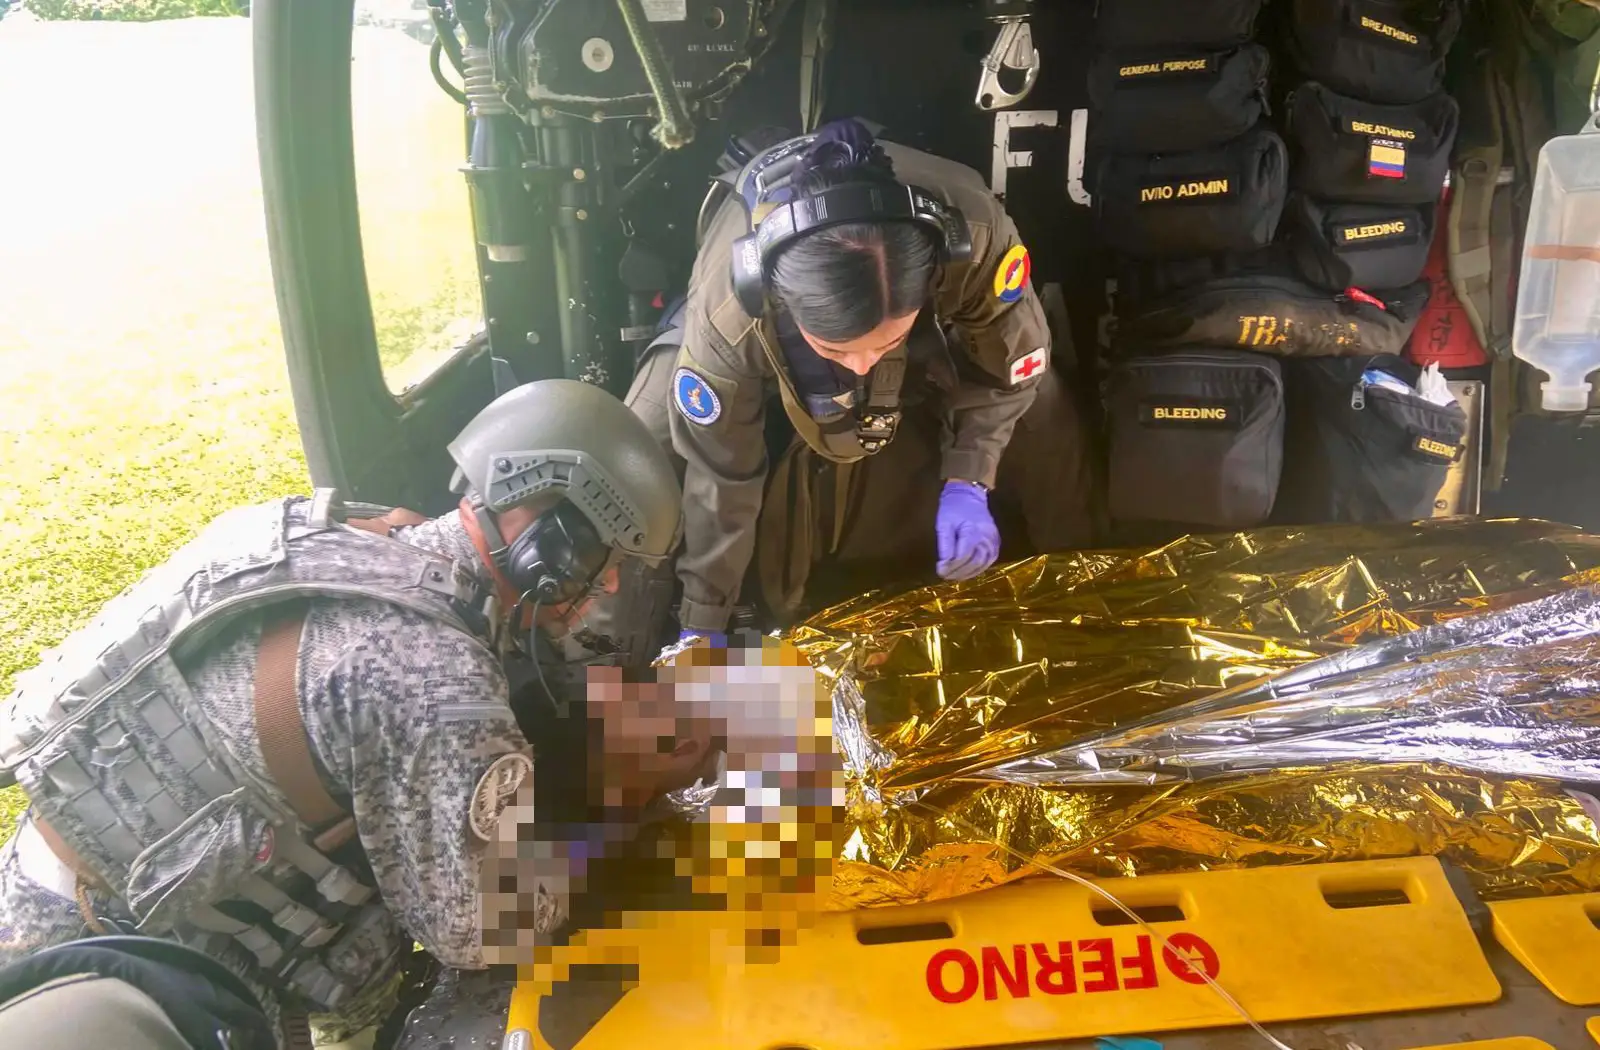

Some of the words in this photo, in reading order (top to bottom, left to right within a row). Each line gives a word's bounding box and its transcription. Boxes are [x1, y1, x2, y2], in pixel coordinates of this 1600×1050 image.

[1361, 16, 1418, 44] BREATHING
[1120, 63, 1160, 76] GENERAL
[1162, 59, 1206, 71] PURPOSE
[1352, 121, 1416, 139] BREATHING
[1177, 180, 1228, 197] ADMIN
[1344, 221, 1406, 240] BLEEDING
[1154, 407, 1227, 420] BLEEDING
[1419, 437, 1457, 458] BLEEDING
[926, 935, 1158, 1004] FERNO
